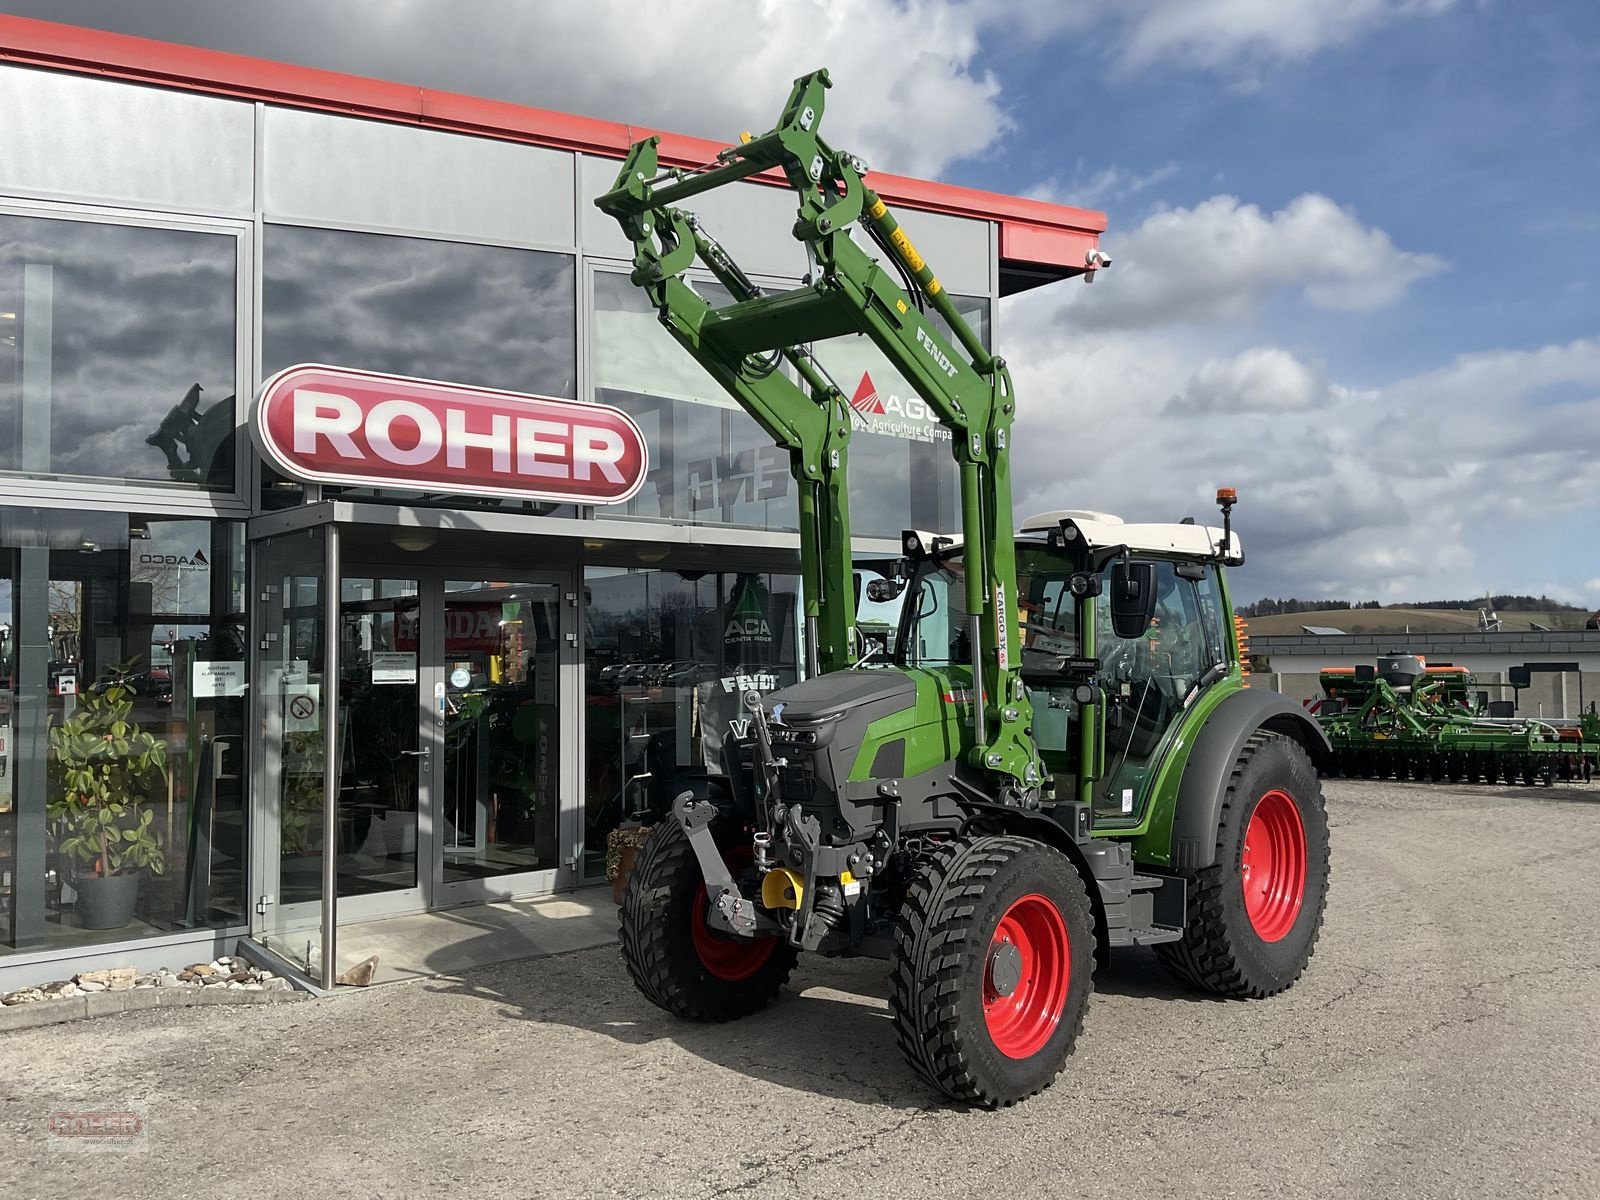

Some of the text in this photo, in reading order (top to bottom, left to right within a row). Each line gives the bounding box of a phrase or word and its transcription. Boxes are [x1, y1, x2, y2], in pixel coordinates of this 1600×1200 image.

[916, 325, 959, 378] FENDT
[885, 394, 941, 423] AGC
[293, 388, 628, 485] ROHER
[872, 418, 924, 436] Agriculture
[923, 425, 953, 441] Compa
[996, 591, 1006, 633] CARGO
[724, 619, 772, 636] ACA
[999, 636, 1007, 650] 3X
[720, 673, 780, 693] FENDT
